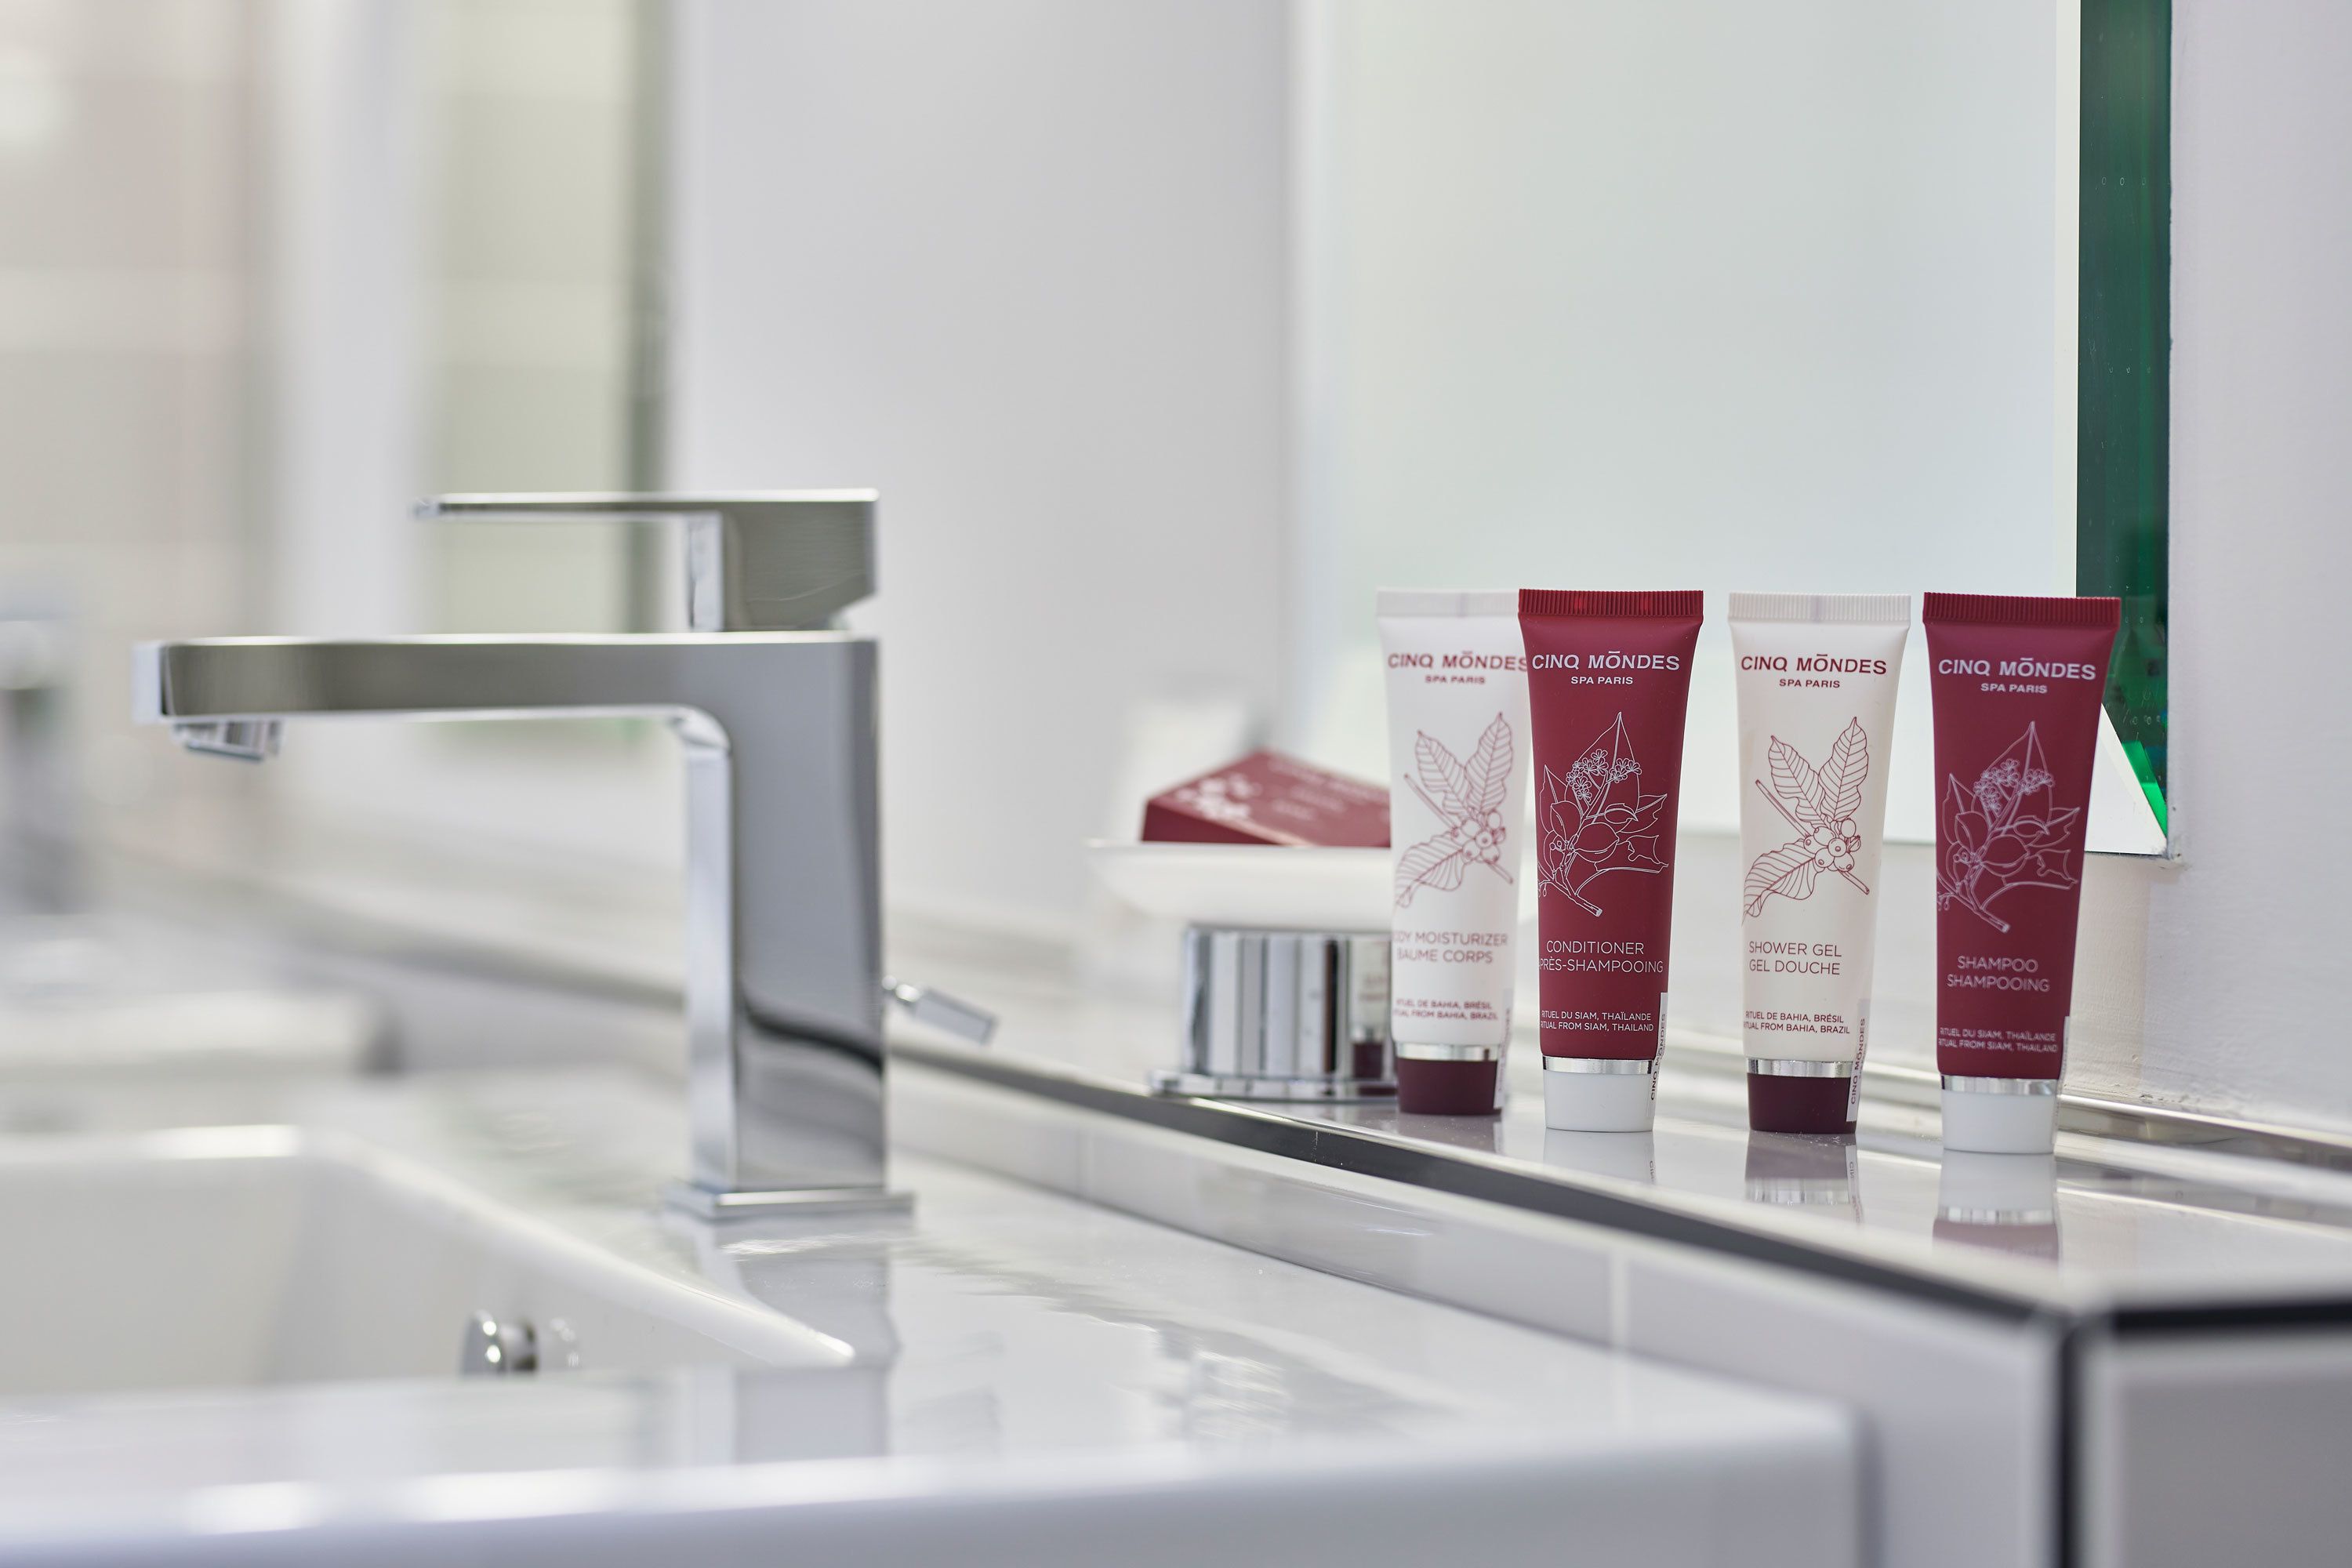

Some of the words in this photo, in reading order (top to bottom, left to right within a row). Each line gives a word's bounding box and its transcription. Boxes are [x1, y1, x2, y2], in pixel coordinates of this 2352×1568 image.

[1388, 653, 1433, 669] CINQ
[1532, 654, 1579, 670] CINQ
[1588, 651, 1680, 670] MŌNDES
[1740, 656, 1788, 672] CINQ
[1796, 654, 1887, 674] MŌNDES
[1938, 659, 1990, 677] CINQ
[1999, 657, 2096, 681] MŌNDES
[1451, 676, 1486, 684] PARIS
[1806, 680, 1840, 688] PARIS
[1980, 683, 2005, 691] SPA
[2009, 684, 2048, 694] PARIS
[1415, 931, 1508, 947] MOISTURIZER
[1546, 941, 1644, 955] CONDITIONER
[1749, 941, 1807, 955] SHOWER
[1813, 944, 1842, 957] GEL
[1443, 949, 1494, 964] CORPS
[1539, 956, 1664, 973] PRÈS-SHAMPOOING
[1749, 959, 1770, 972] GEL
[1775, 960, 1840, 975] DOUCHE
[1958, 956, 2038, 973] SHAMPOO
[1947, 974, 2050, 993] SHAMPOOING
[1541, 1010, 1559, 1018] RITUEL
[1575, 1012, 1599, 1021] SIAM,
[1602, 1011, 1651, 1021] THAÏLANDE
[1780, 1013, 1811, 1022] BAHIA,
[1813, 1013, 1844, 1023] BRÉSIL
[1584, 1022, 1610, 1032] SIAM,
[1761, 1022, 1784, 1031] FROM
[1786, 1024, 1817, 1033] BAHIA,
[1820, 1025, 1849, 1034] BRAZIL
[1962, 1029, 1976, 1038] DU
[1977, 1029, 2002, 1040] SIAM,
[1960, 1040, 1984, 1049] FROM
[1987, 1041, 2013, 1051] SIAM,
[2017, 1043, 2057, 1053] THAILAND
